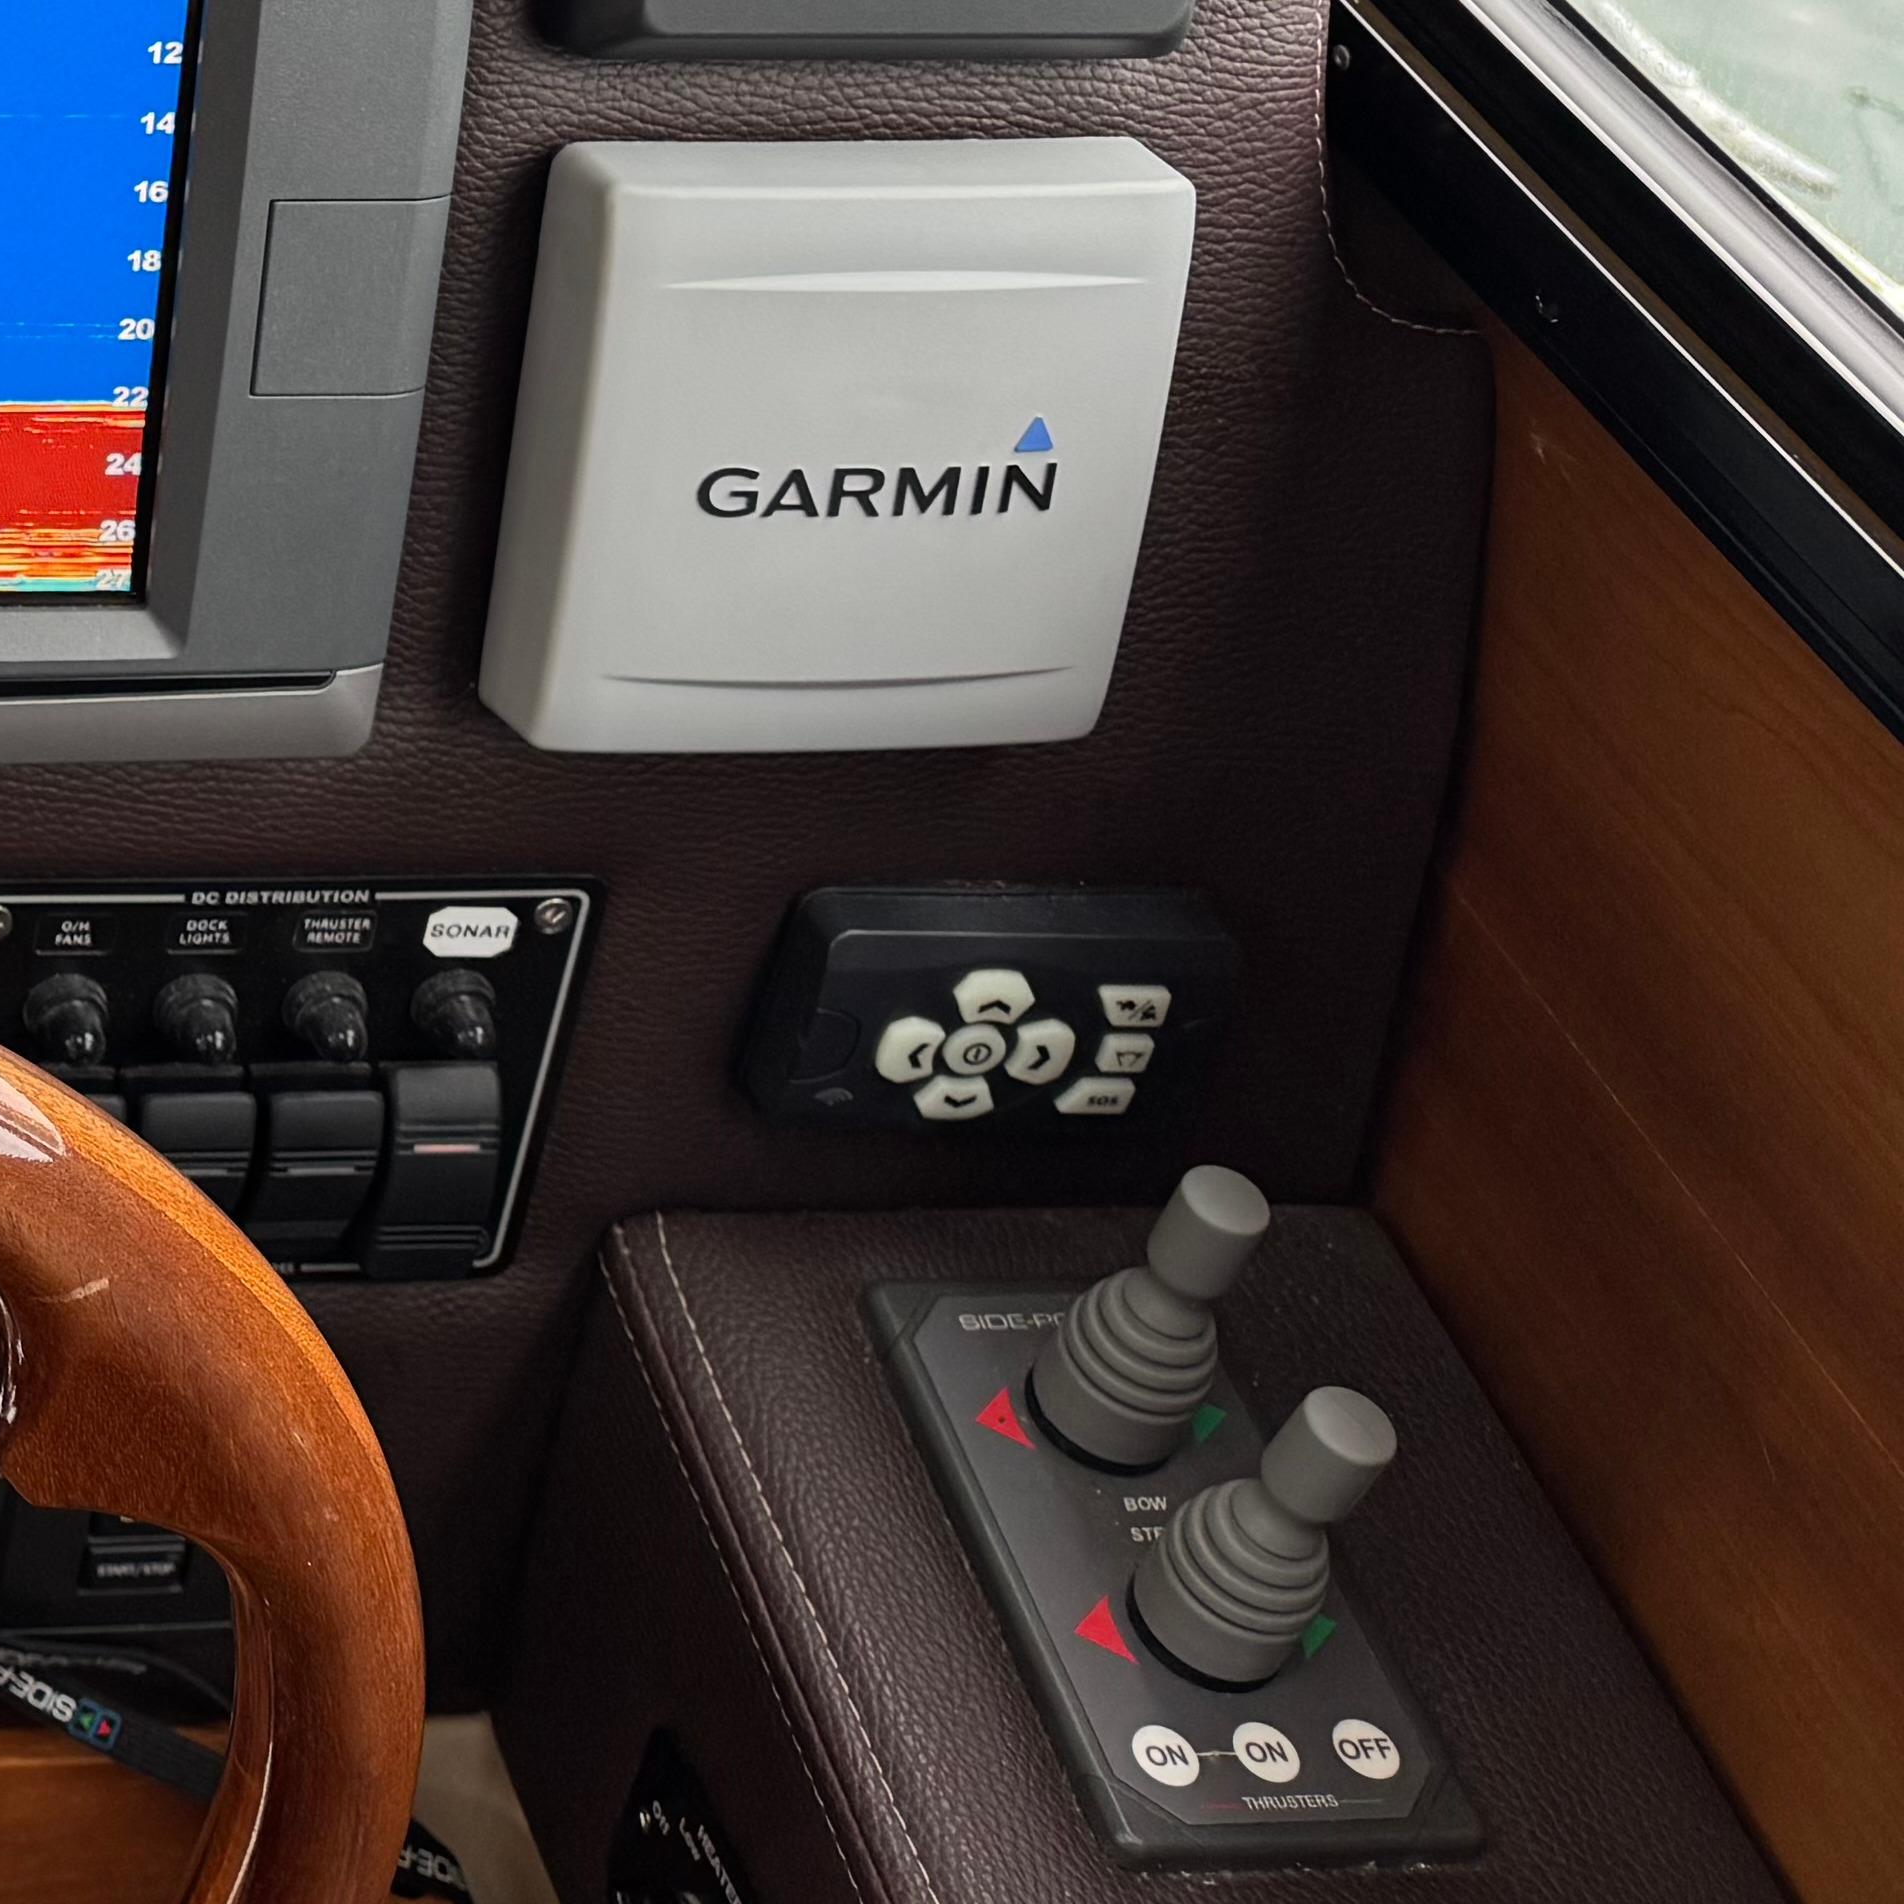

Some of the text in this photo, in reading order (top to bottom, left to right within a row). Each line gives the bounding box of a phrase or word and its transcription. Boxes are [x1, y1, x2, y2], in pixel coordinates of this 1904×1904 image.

[147, 41, 184, 66] 12
[140, 111, 176, 135] 14
[133, 180, 169, 204] 16
[127, 249, 162, 273] 18
[118, 317, 155, 341] 20
[112, 386, 149, 408] 22
[105, 452, 143, 477] 24
[696, 462, 1058, 518] GARMIN
[99, 519, 136, 543] 26
[191, 890, 370, 905] DC DISTRIBUTION
[61, 920, 91, 932] O/H
[186, 919, 228, 931] DOCK
[304, 918, 371, 931] THRUSTER
[429, 924, 511, 939] SONAR
[55, 934, 92, 946] FANS
[179, 932, 231, 945] LIGHTS
[306, 931, 362, 944] REMOTE
[1123, 1496, 1167, 1512] BOW
[1145, 1738, 1392, 1765] ON ON OFF
[1240, 1793, 1339, 1811] THRUSTERS
